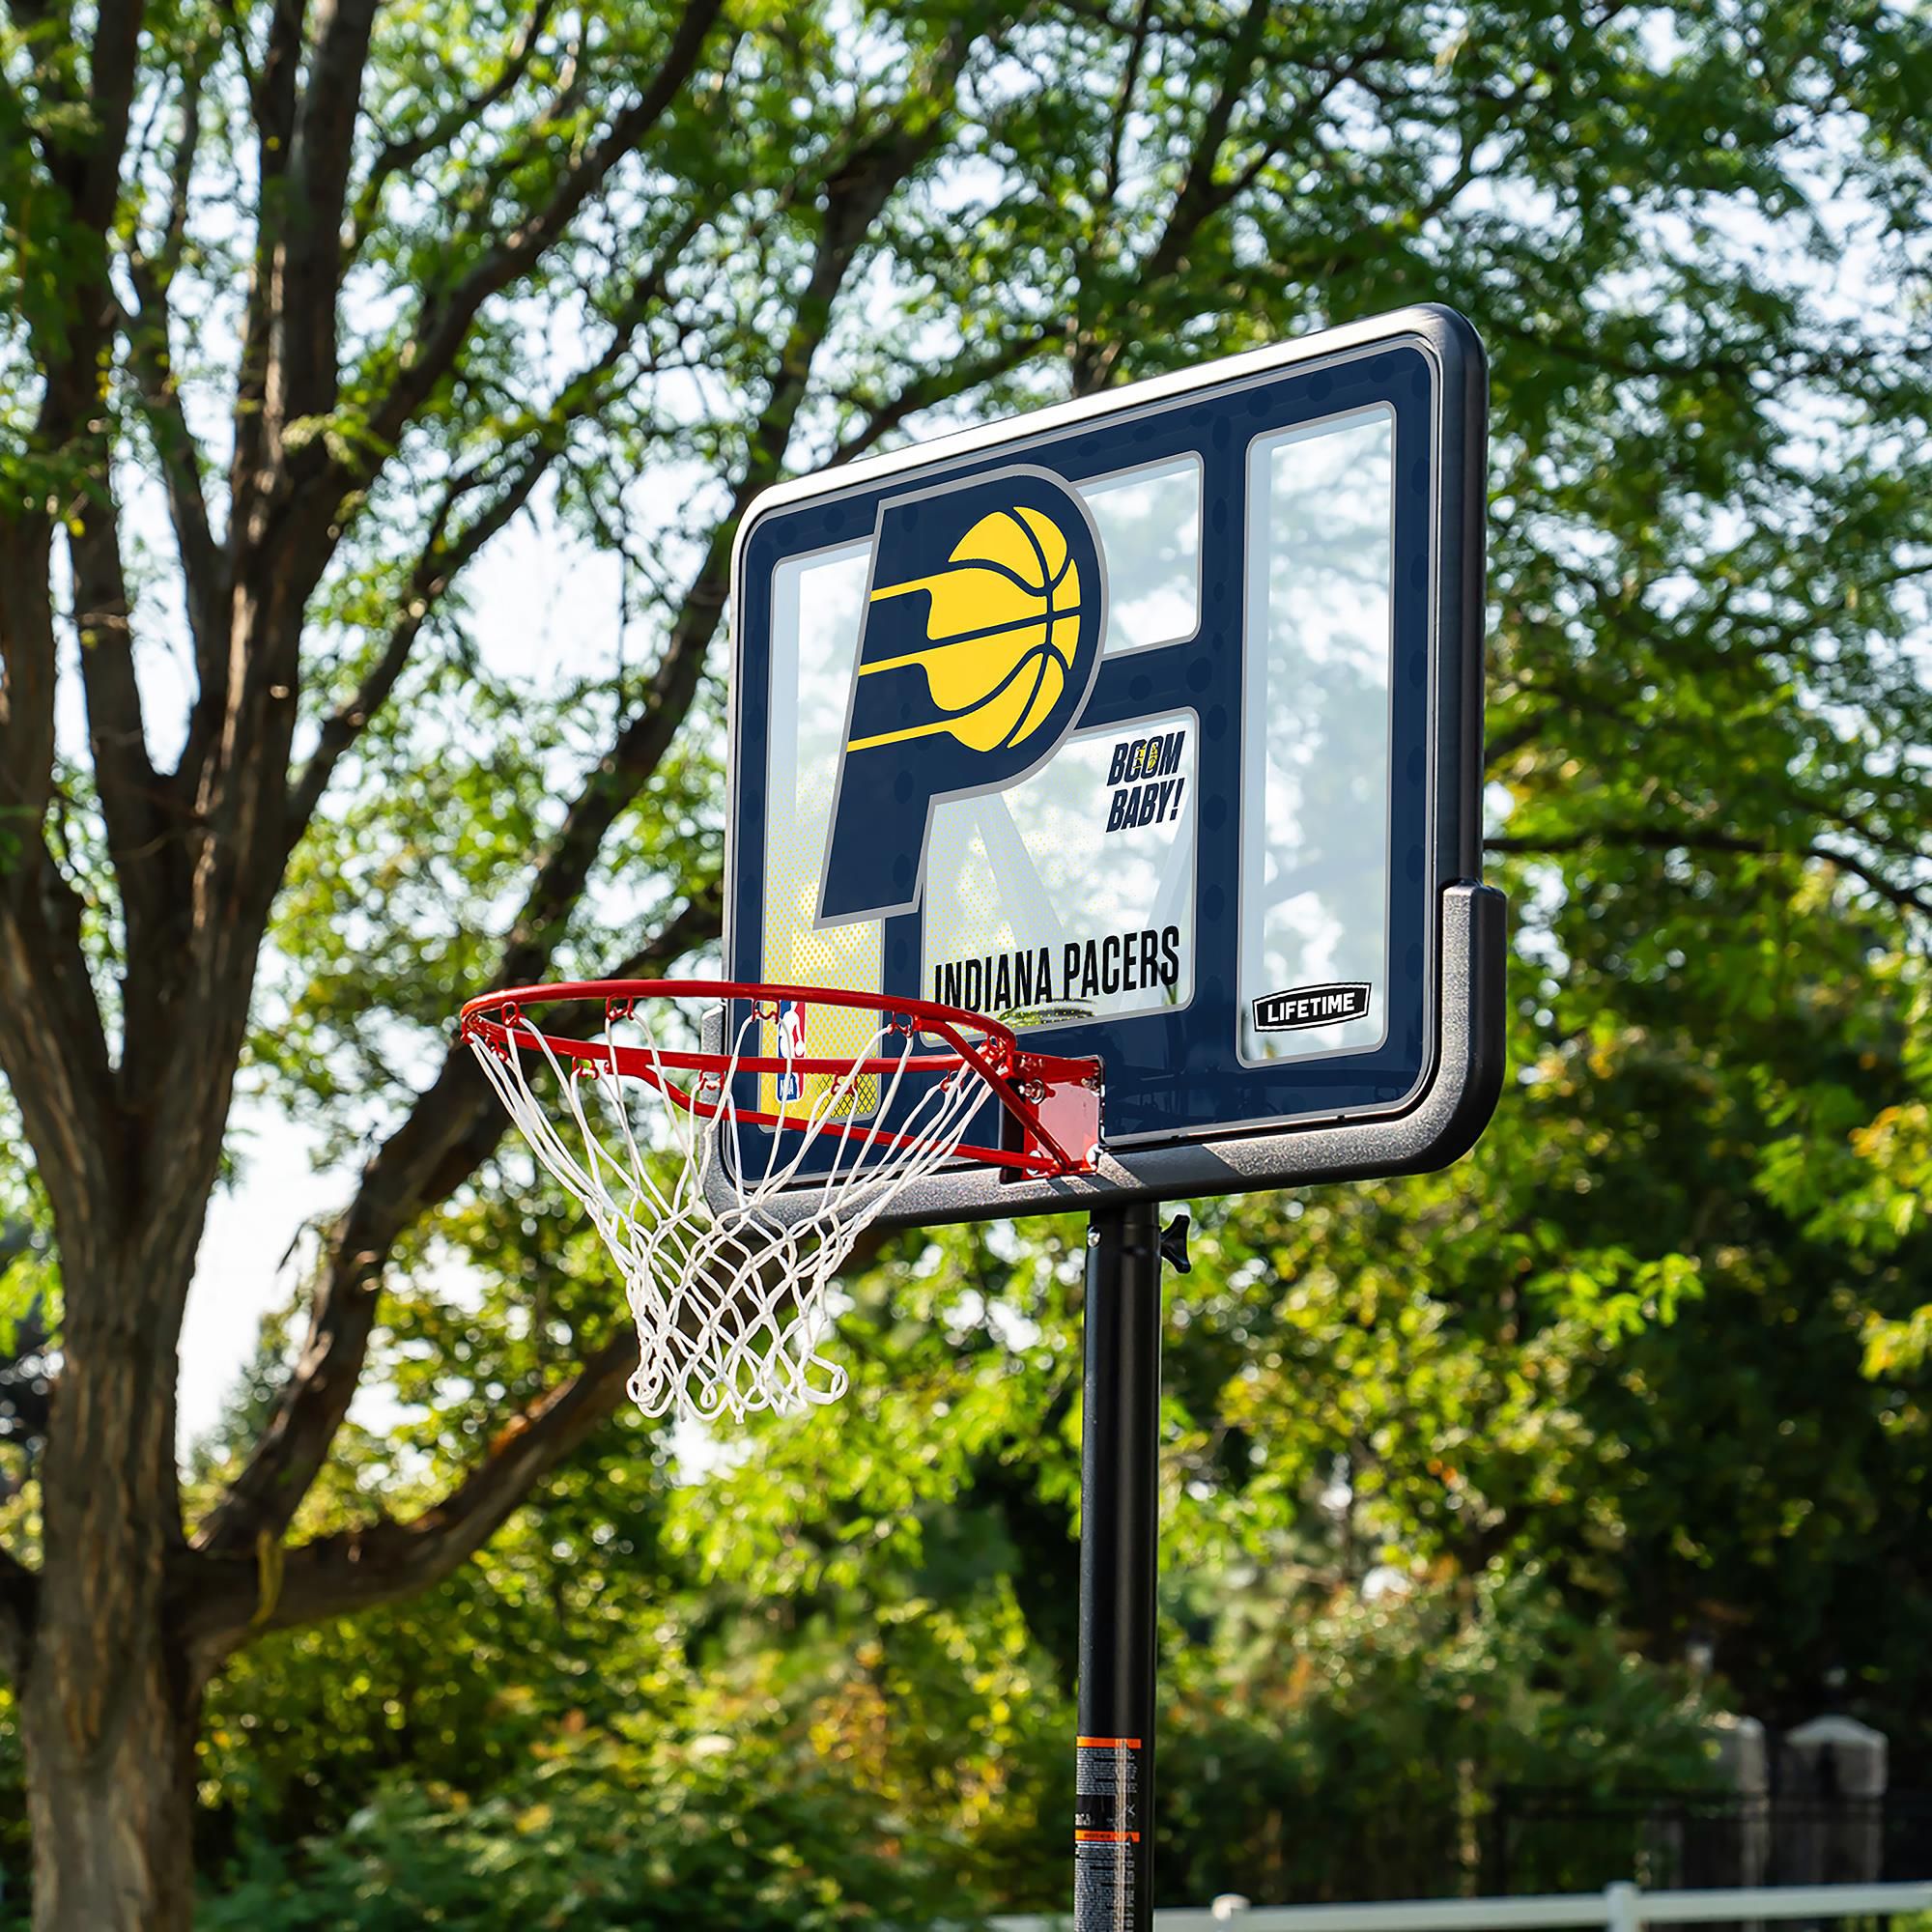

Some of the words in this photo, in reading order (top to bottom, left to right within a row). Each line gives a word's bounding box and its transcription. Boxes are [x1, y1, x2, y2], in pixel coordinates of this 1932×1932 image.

[1107, 730, 1186, 786] BOOM
[1106, 778, 1186, 833] BABY!
[935, 947, 1053, 1012] INDIANA
[1064, 925, 1180, 1000] PACERS
[1266, 992, 1355, 1023] LIFETIME
